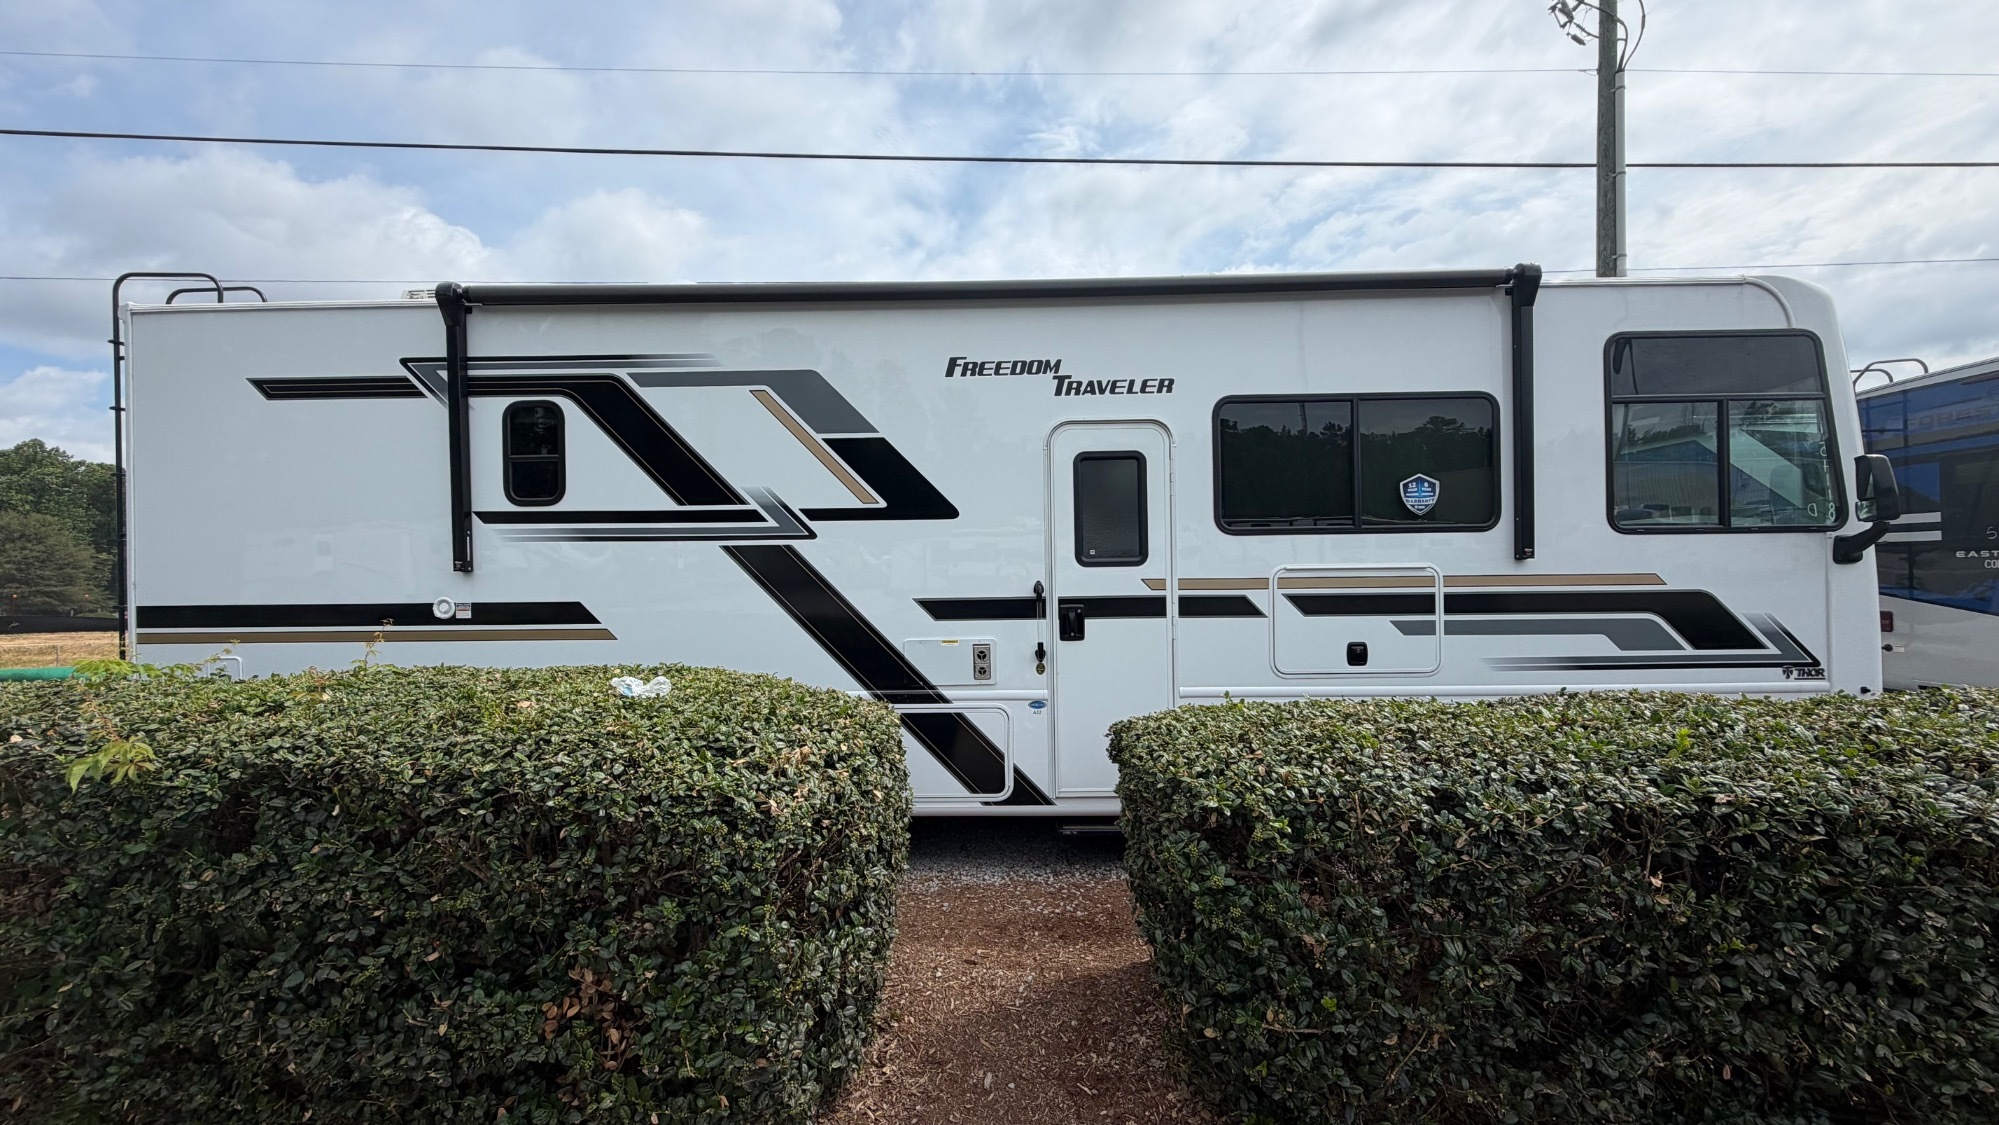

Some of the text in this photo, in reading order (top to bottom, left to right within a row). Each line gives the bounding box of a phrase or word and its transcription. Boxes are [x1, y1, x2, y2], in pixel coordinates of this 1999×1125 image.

[1986, 526, 1999, 540] 5
[1984, 559, 1999, 569] CO
[1794, 668, 1825, 678] THOR
